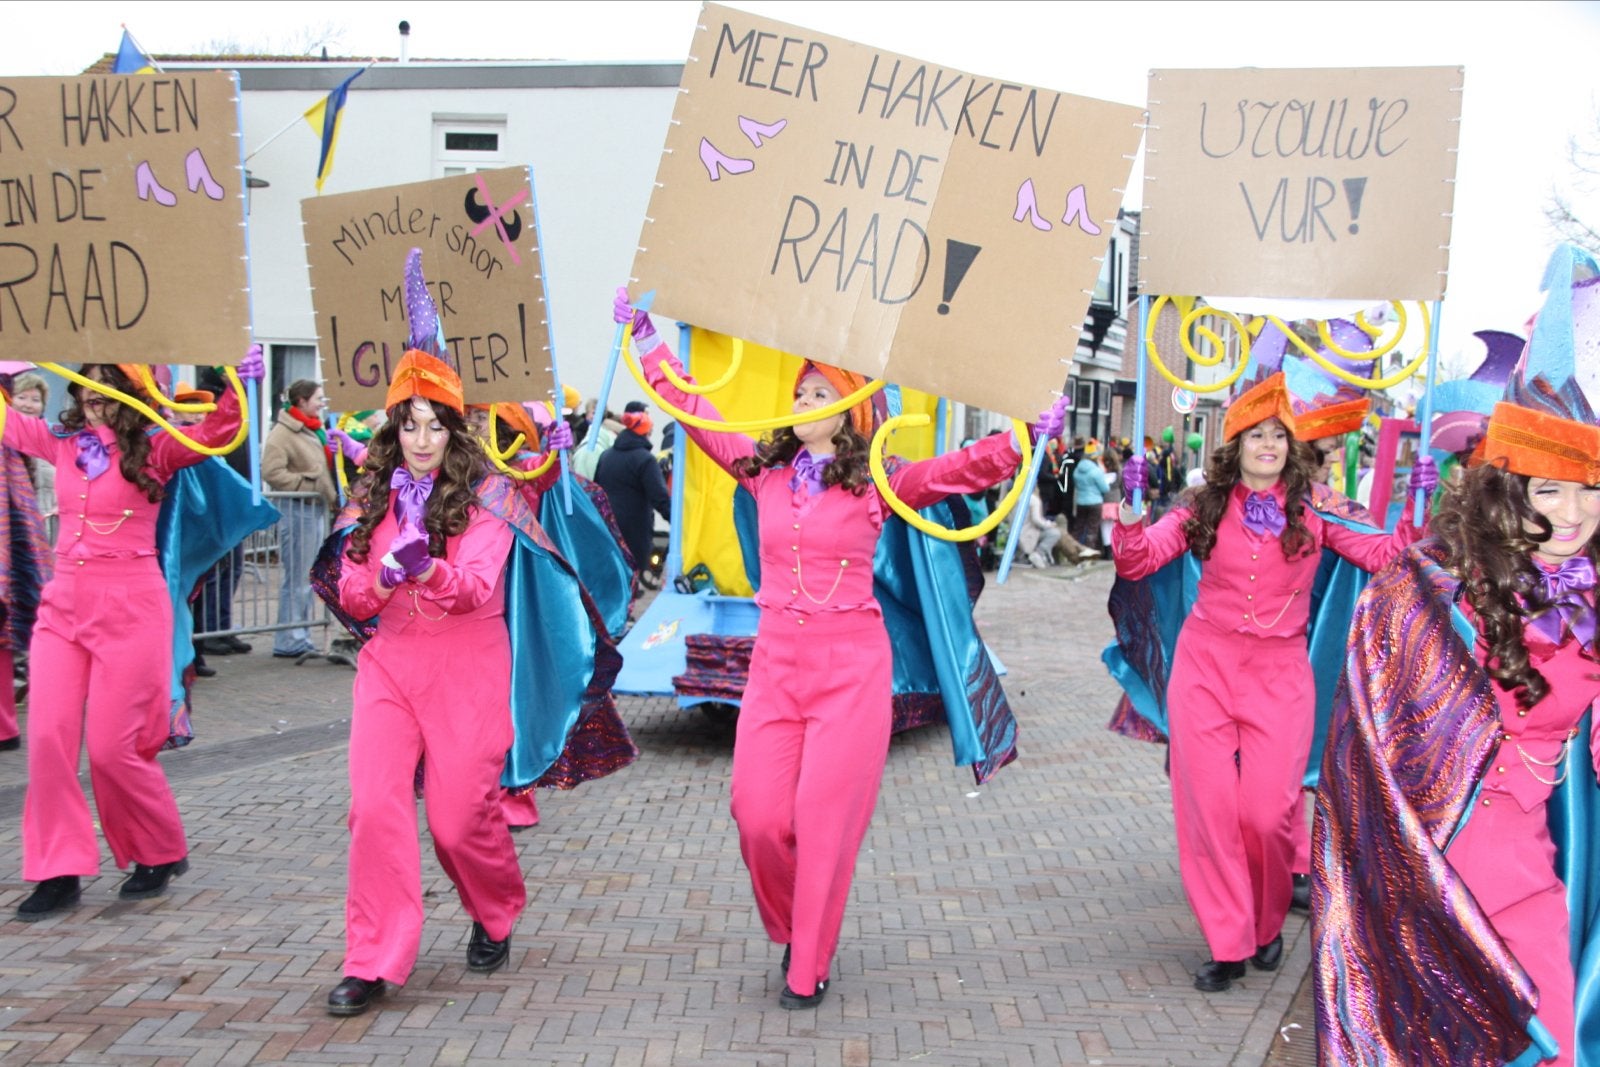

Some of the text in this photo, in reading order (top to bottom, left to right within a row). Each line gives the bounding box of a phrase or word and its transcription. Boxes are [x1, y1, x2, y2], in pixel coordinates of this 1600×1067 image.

[61, 77, 200, 147] HAKKEN
[709, 22, 1061, 157] MEER HAKKEN
[1, 168, 107, 228] IN DE
[823, 140, 940, 206] IN DE
[0, 240, 149, 334] RAAD
[771, 194, 983, 316] RAAD!
[380, 281, 458, 321] MR
